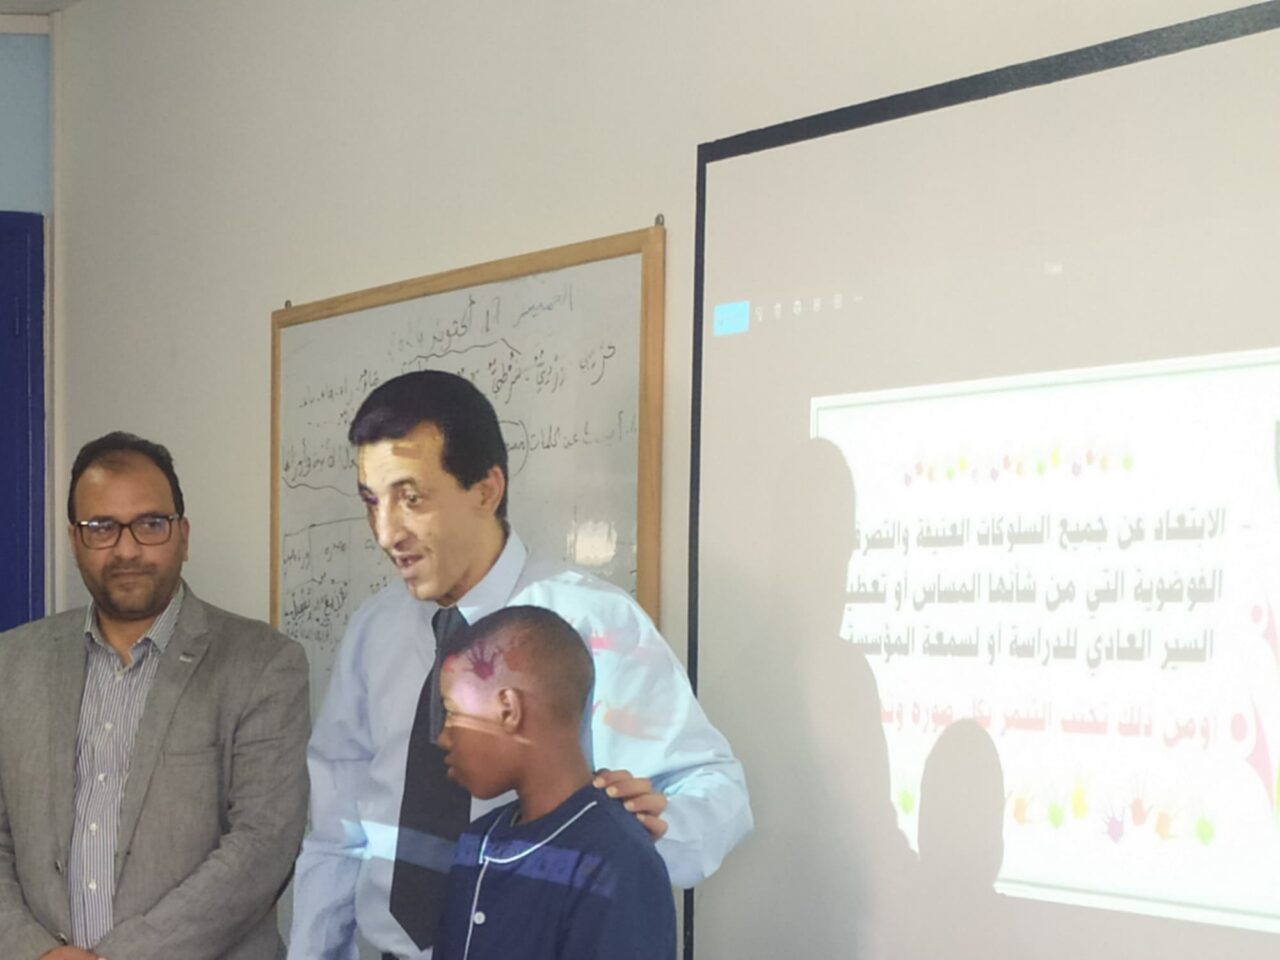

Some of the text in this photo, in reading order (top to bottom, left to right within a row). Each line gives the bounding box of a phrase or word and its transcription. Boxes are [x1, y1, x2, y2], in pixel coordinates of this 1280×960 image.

[916, 517, 970, 555] العنيفة
[977, 513, 1051, 553] السلوكات
[1059, 516, 1108, 551] جميع
[1118, 516, 1146, 550] عن
[1153, 506, 1227, 548] الابتعاد
[843, 572, 888, 612] تعطي
[913, 571, 981, 611] المساس
[1045, 575, 1076, 612] من
[1086, 568, 1124, 619] التي
[1134, 568, 1222, 612] الفوضوية
[922, 626, 979, 657] لسمعة
[1009, 627, 1078, 666] للدراسة
[1086, 628, 1151, 677] العادي
[1161, 628, 1213, 671] السير
